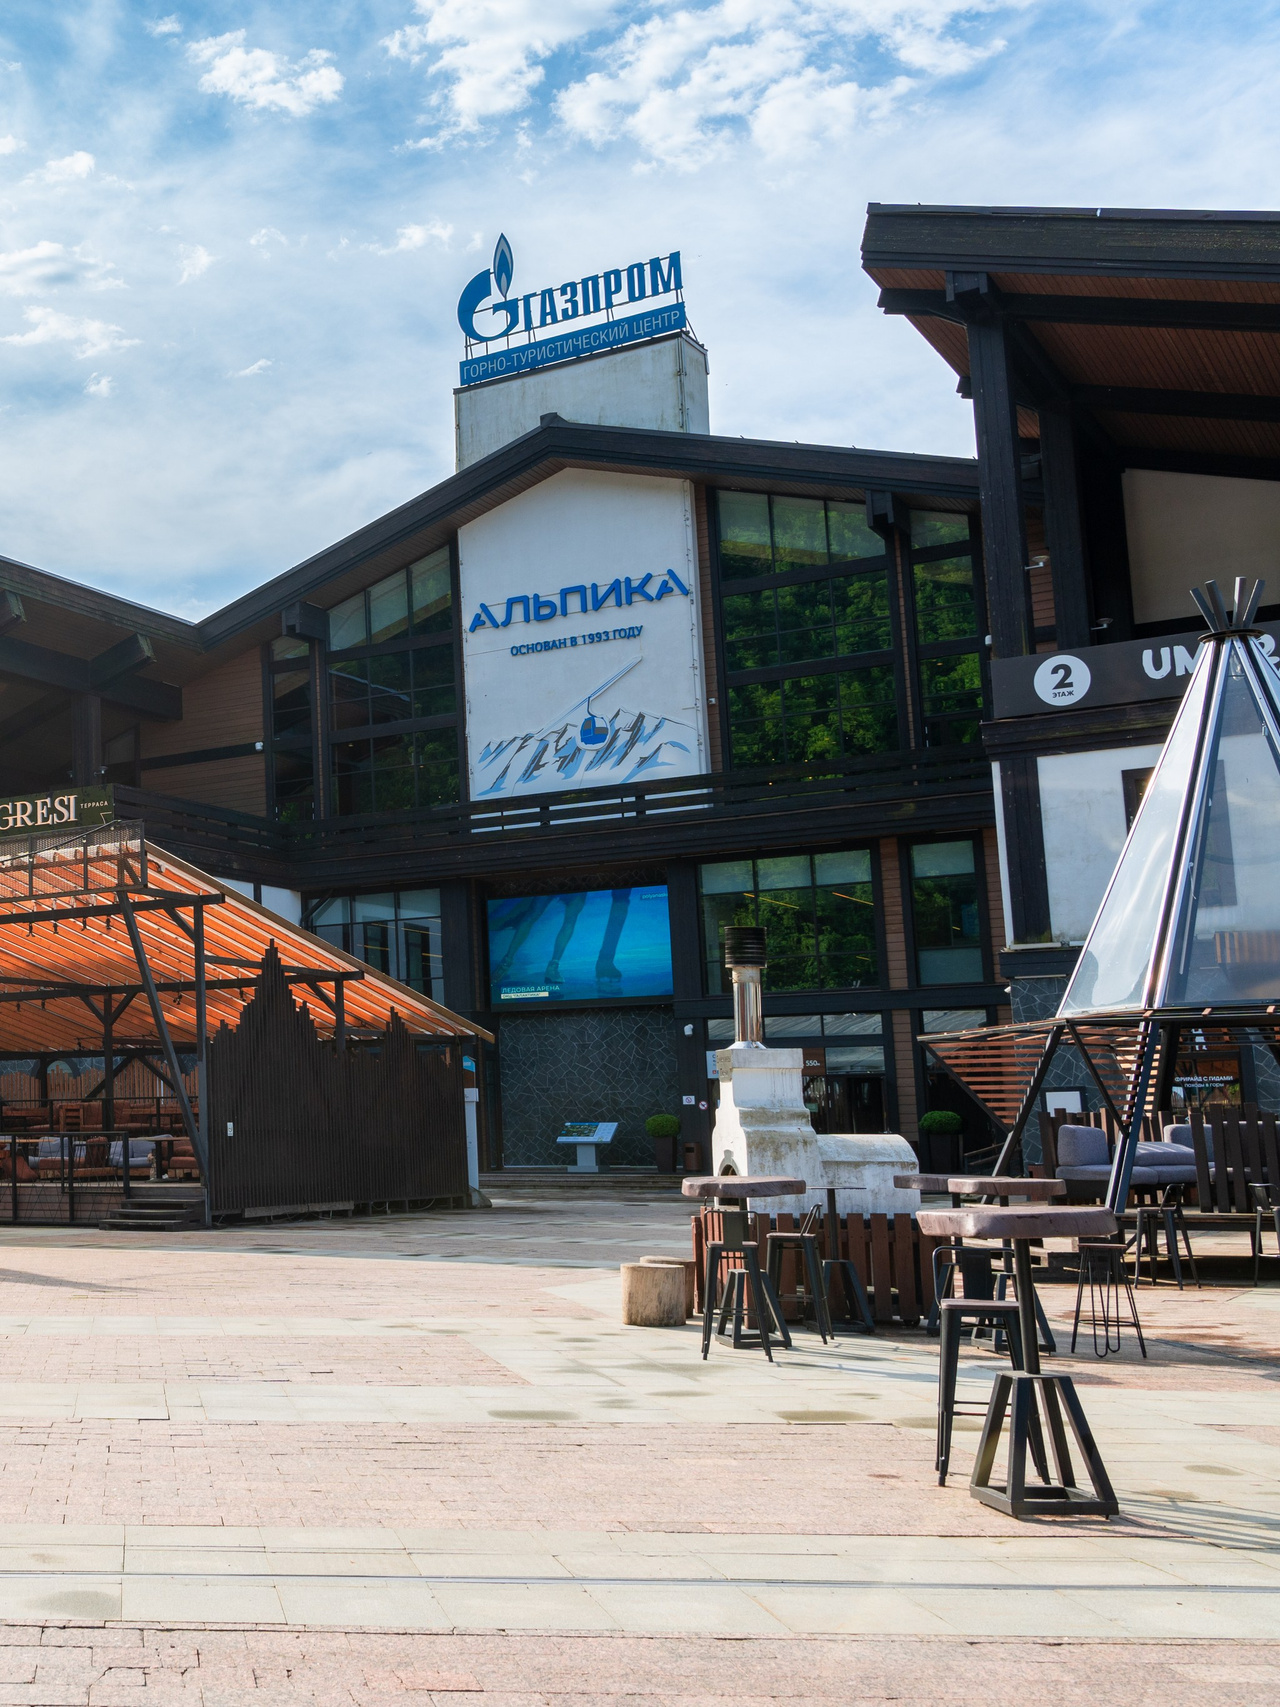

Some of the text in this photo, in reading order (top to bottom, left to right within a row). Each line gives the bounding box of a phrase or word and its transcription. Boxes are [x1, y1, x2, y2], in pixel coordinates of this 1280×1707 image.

[523, 250, 684, 332] ГАЗПРОМ
[463, 310, 680, 380] ГОРНО-ТУРИСТИЧЕСКИЙ ЦЕНТР
[468, 568, 690, 633] АЛЬПИКА
[510, 625, 643, 657] ОСНОВАН В 1993 ГОДУ
[1050, 663, 1074, 691] 2
[1052, 690, 1075, 699] ЭТАЖ
[80, 800, 109, 809] ТЕРРАСА
[501, 986, 535, 994] ЛЕДОВАЯ
